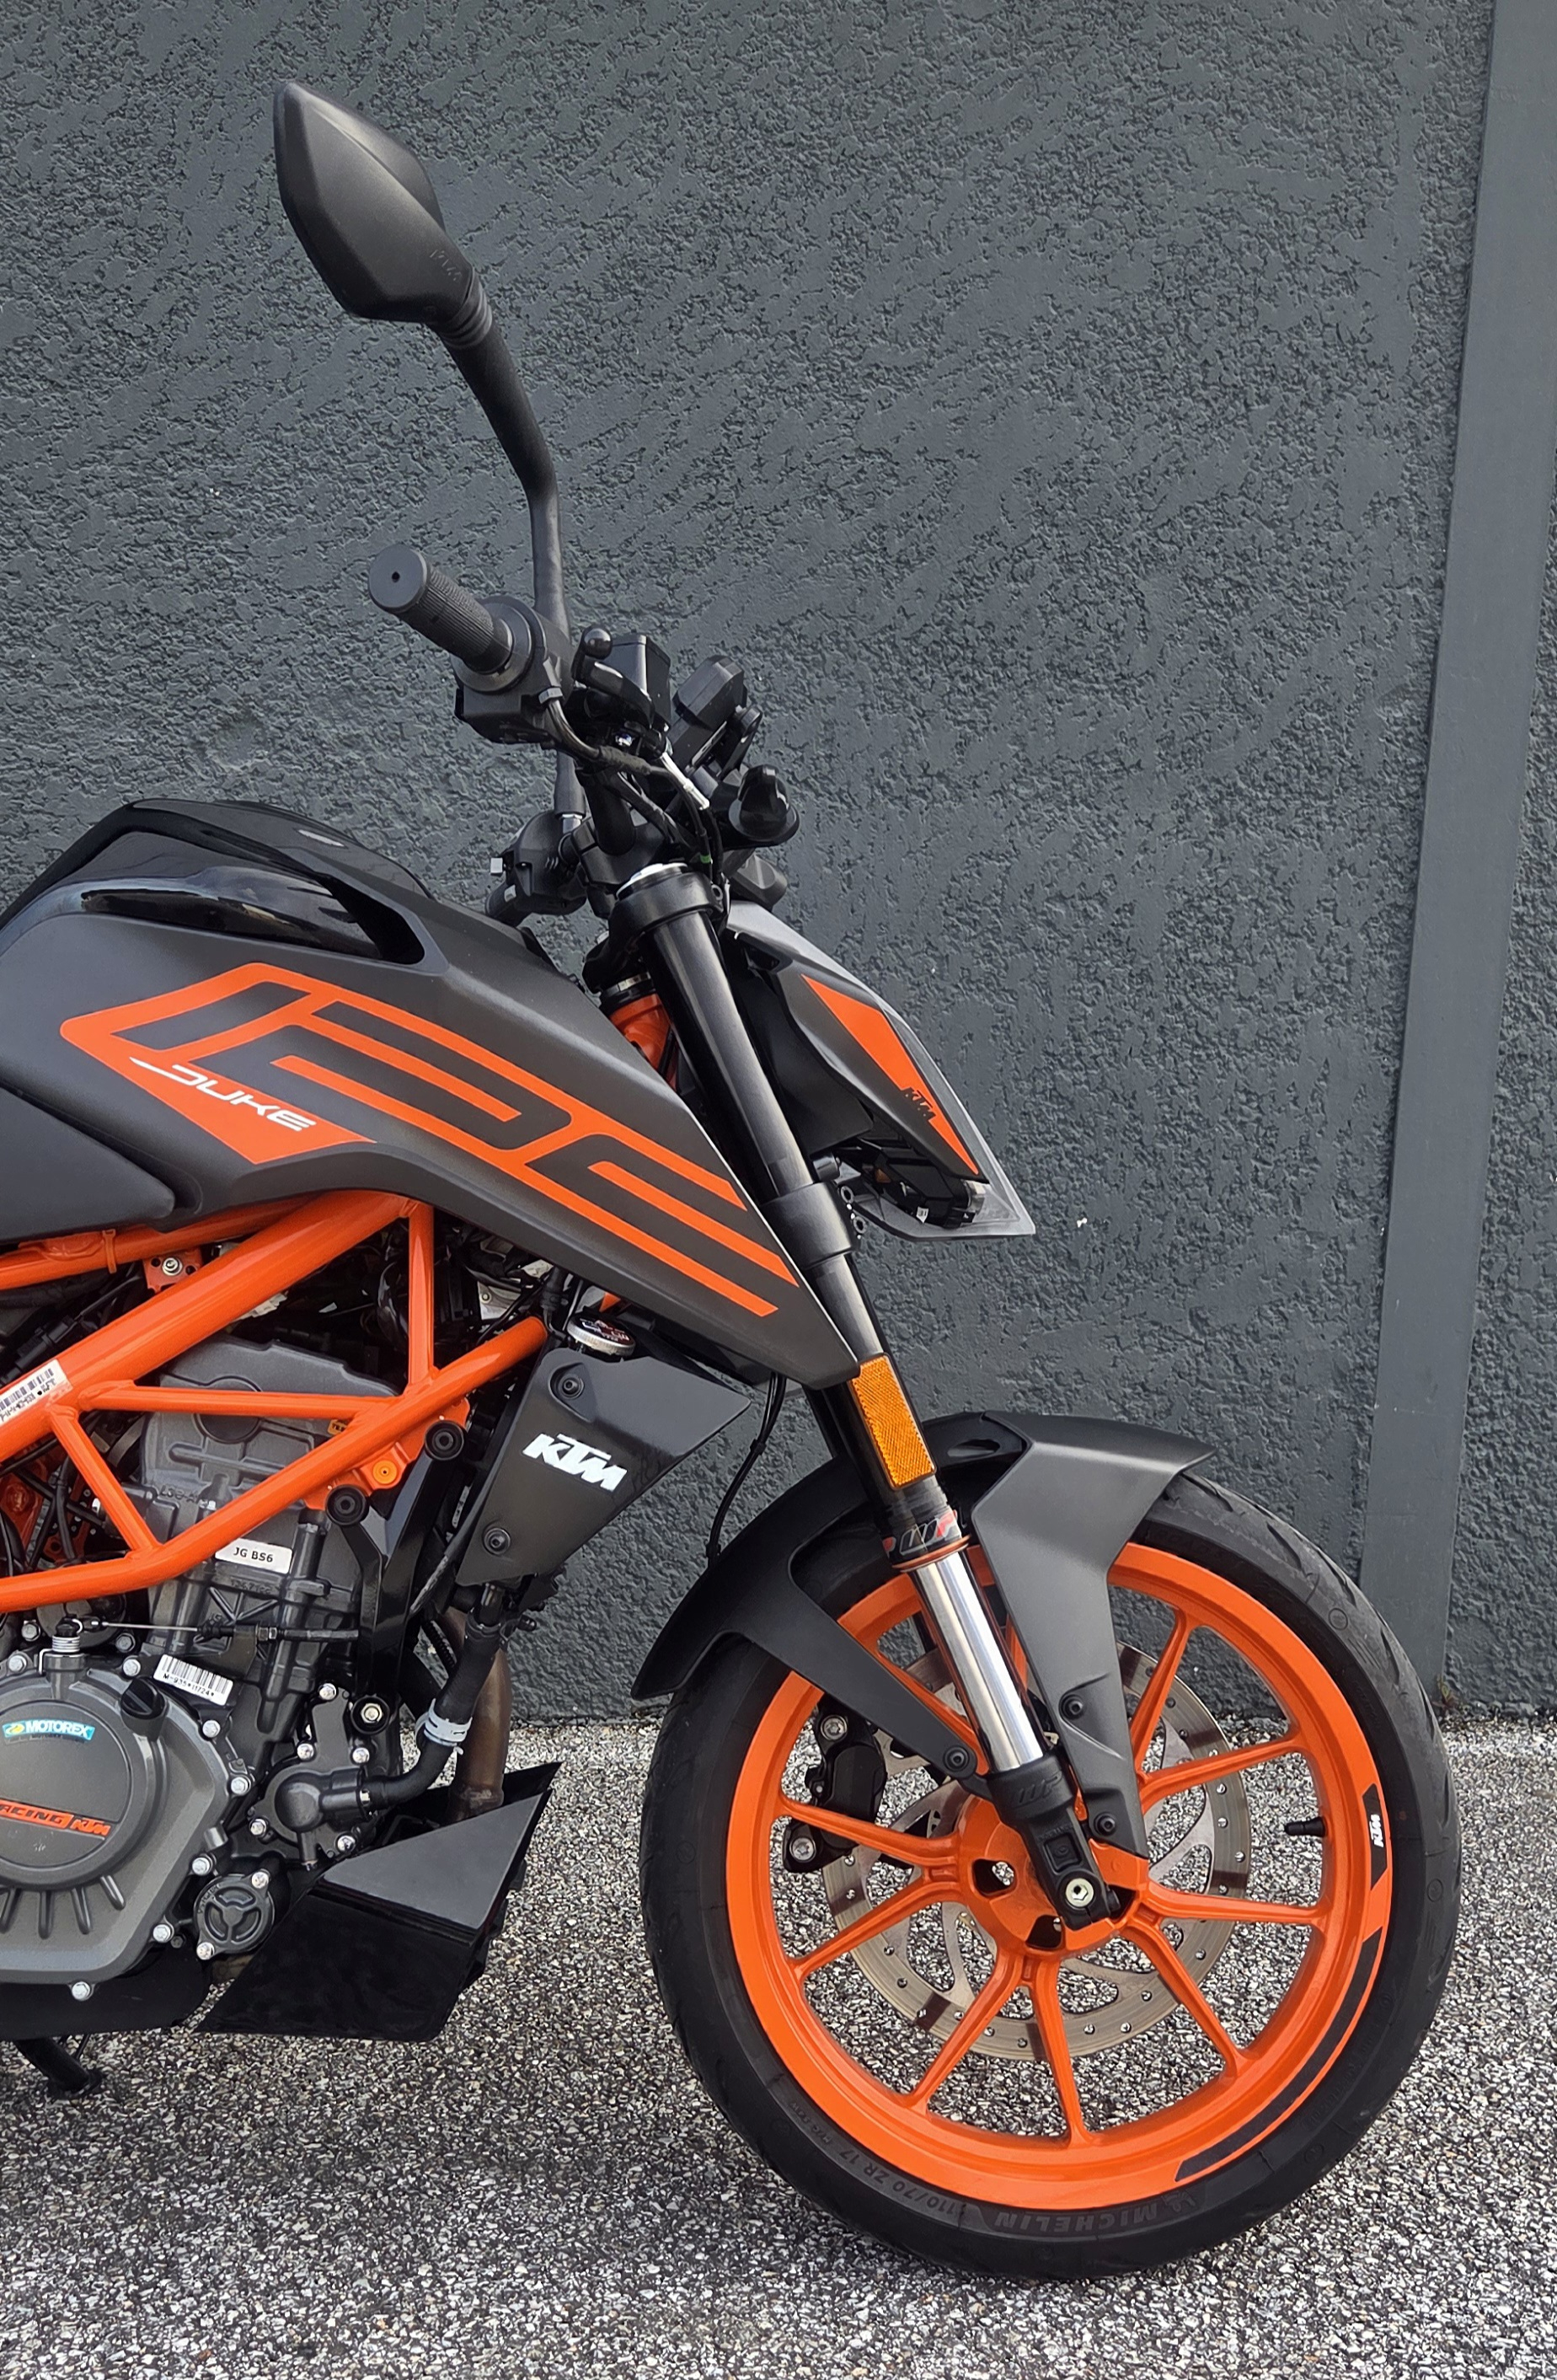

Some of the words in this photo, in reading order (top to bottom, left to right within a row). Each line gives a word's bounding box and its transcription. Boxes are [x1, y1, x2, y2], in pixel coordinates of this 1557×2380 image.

[129, 1057, 317, 1132] DUKE
[522, 1434, 628, 1492] KTM
[233, 1547, 249, 1558] JG
[251, 1551, 274, 1563] BS6
[25, 1720, 92, 1740] MOTOREX
[70, 1818, 110, 1836] KTM
[1369, 1814, 1384, 1847] KTM
[839, 2148, 860, 2165] 17
[863, 2162, 890, 2184] ZR
[892, 2180, 956, 2215] 110/70
[993, 2202, 1158, 2233] MICHELIN
